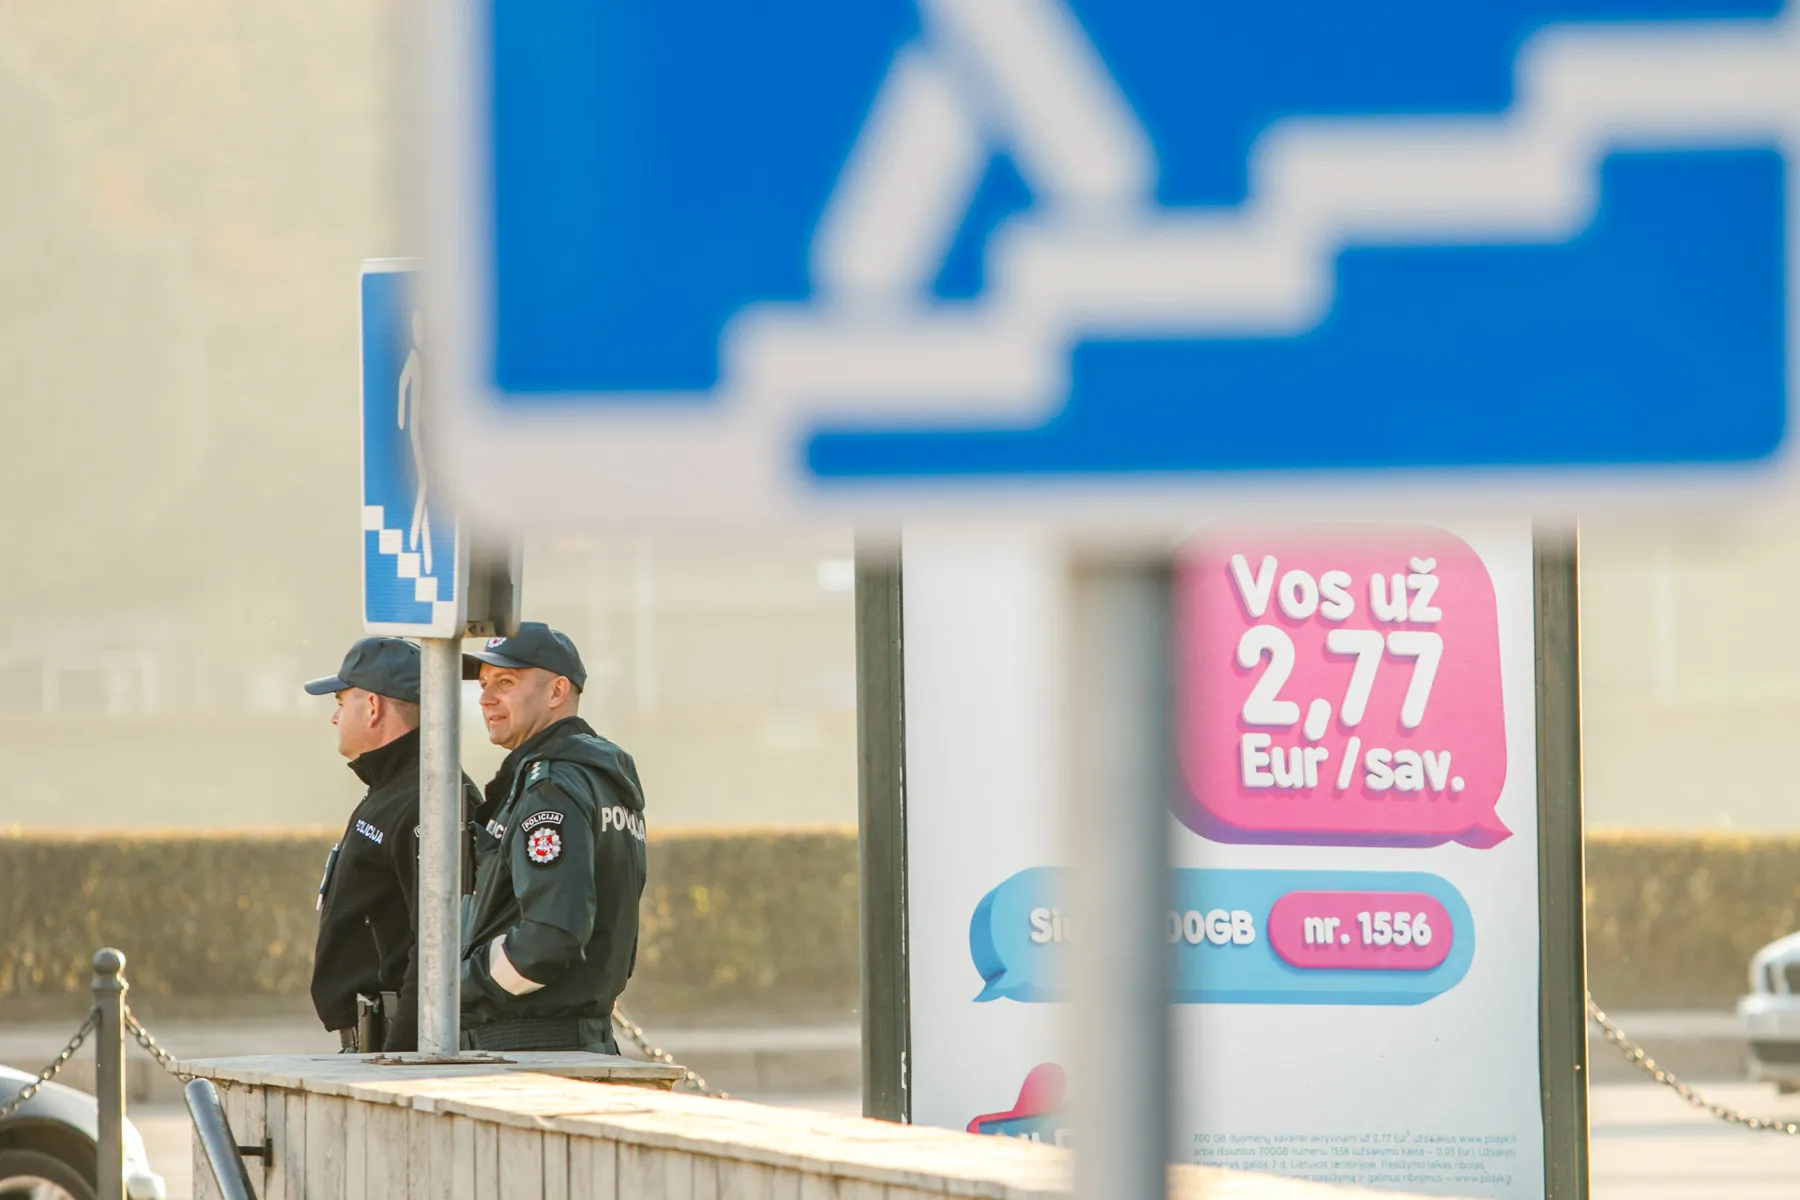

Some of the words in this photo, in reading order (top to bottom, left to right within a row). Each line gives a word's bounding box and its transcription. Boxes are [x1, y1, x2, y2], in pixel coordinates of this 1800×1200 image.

[1229, 553, 1355, 621] Vos
[1369, 556, 1443, 623] už
[1236, 624, 1444, 742] 2,77
[1240, 732, 1329, 790] Eur
[355, 818, 384, 844] POLICIJA
[524, 813, 560, 829] POLICIJA
[1166, 907, 1256, 946] 00GB
[1303, 916, 1350, 944] nr.
[1356, 911, 1432, 946] 1556
[1193, 1133, 1210, 1143] 700
[1213, 1133, 1226, 1143] GB
[1193, 1147, 1214, 1156] arba
[1259, 1146, 1289, 1156] 700GB
[1331, 1146, 1350, 1156] 1556
[1402, 1146, 1425, 1156] kaina
